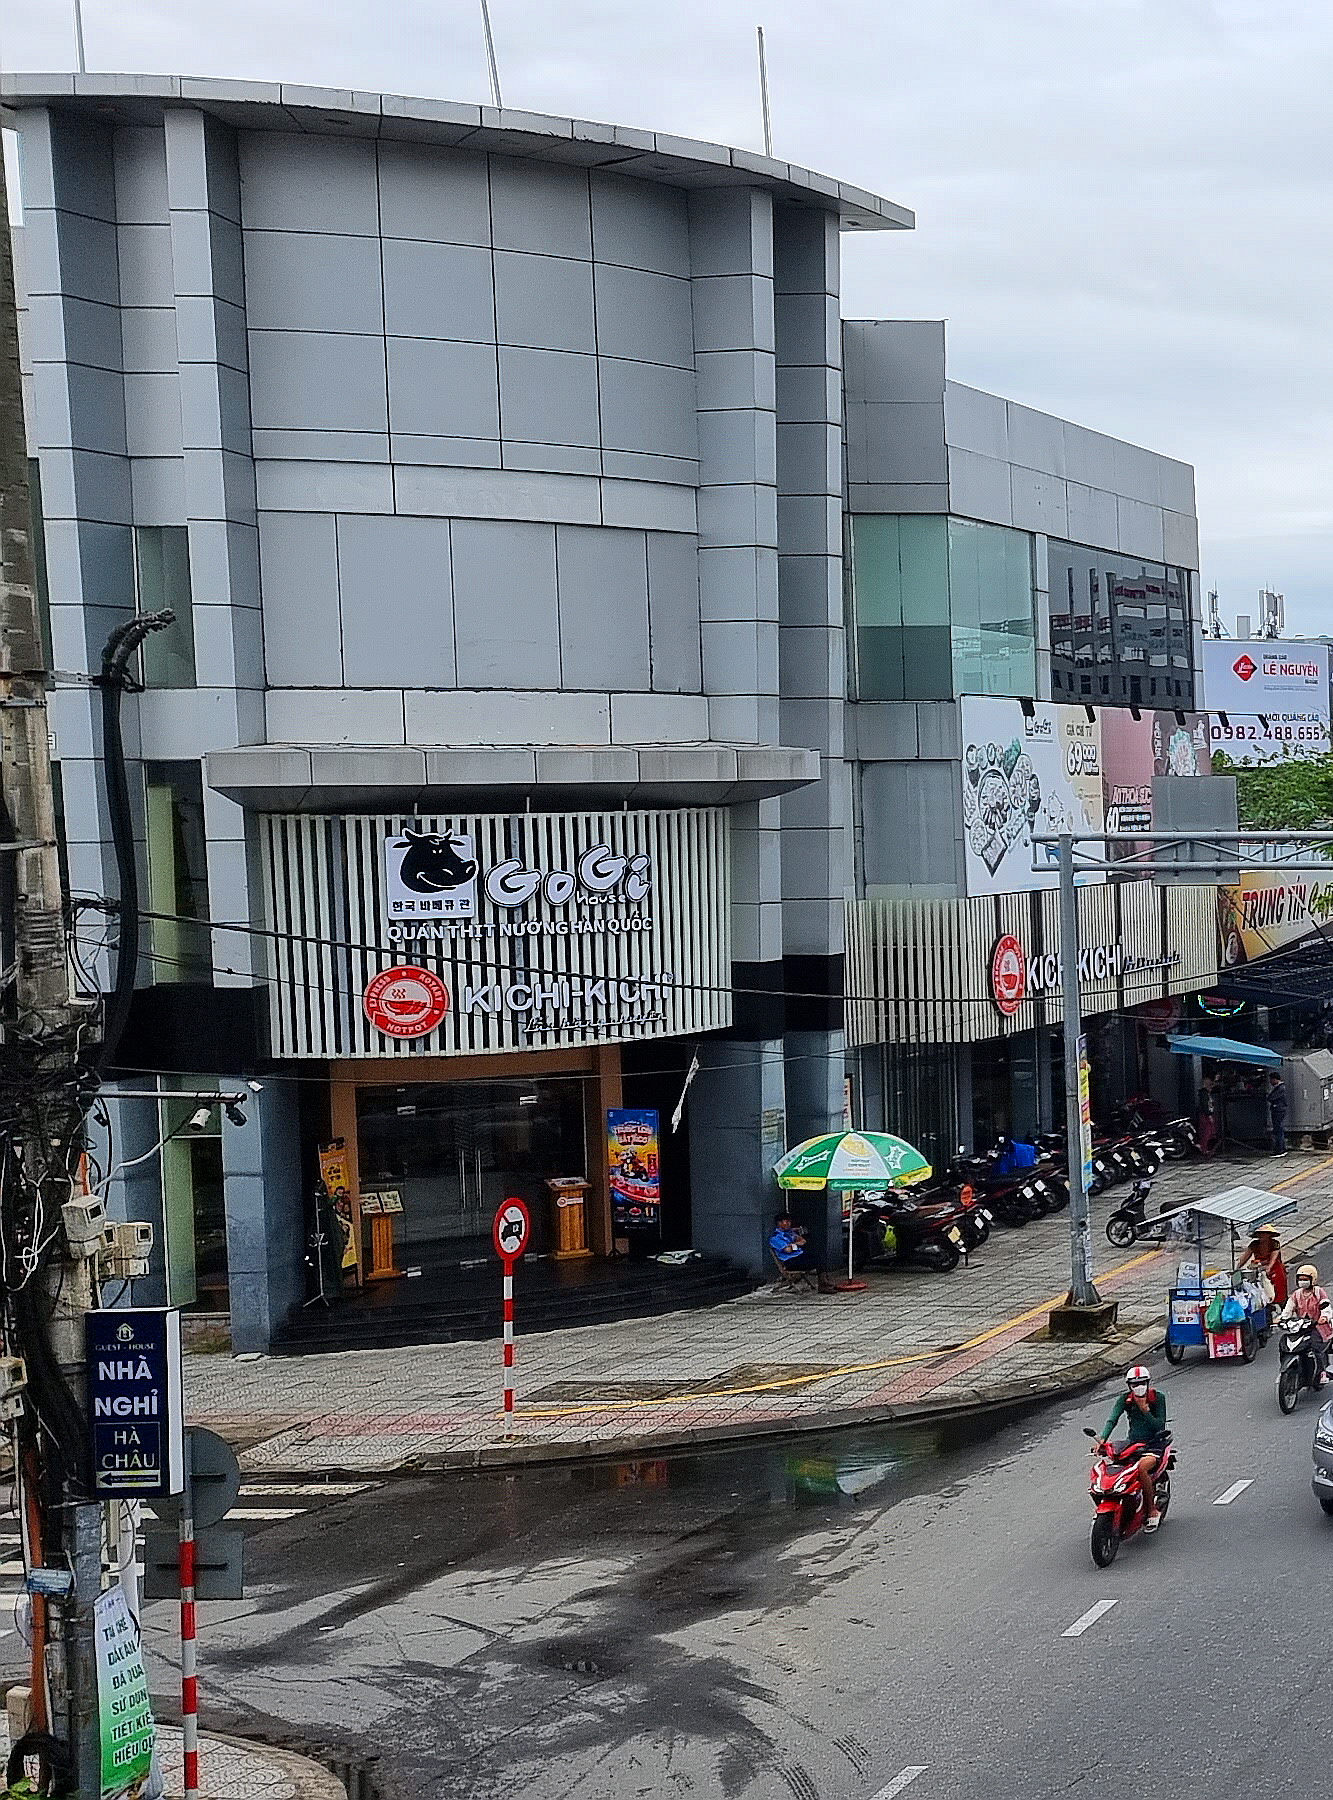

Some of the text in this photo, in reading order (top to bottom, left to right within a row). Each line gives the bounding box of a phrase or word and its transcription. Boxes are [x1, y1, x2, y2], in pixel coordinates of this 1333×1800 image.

[1263, 660, 1277, 675] LÊ
[1211, 725, 1320, 741] 0982.488.655
[1067, 741, 1083, 776] 69
[576, 890, 627, 906] house
[1241, 886, 1286, 931] TRUNG
[1287, 874, 1307, 922] TÍN
[387, 908, 653, 942] QUÁN THỊT NƯỚNG HÀN QUỐC
[466, 973, 669, 1014] KICHI-KICHI
[386, 1020, 430, 1033] HOTPOT
[98, 1355, 153, 1381] NHÀ
[95, 1388, 159, 1417] NGHỈ
[114, 1425, 141, 1446] HÀ
[102, 1448, 155, 1469] CHÂU
